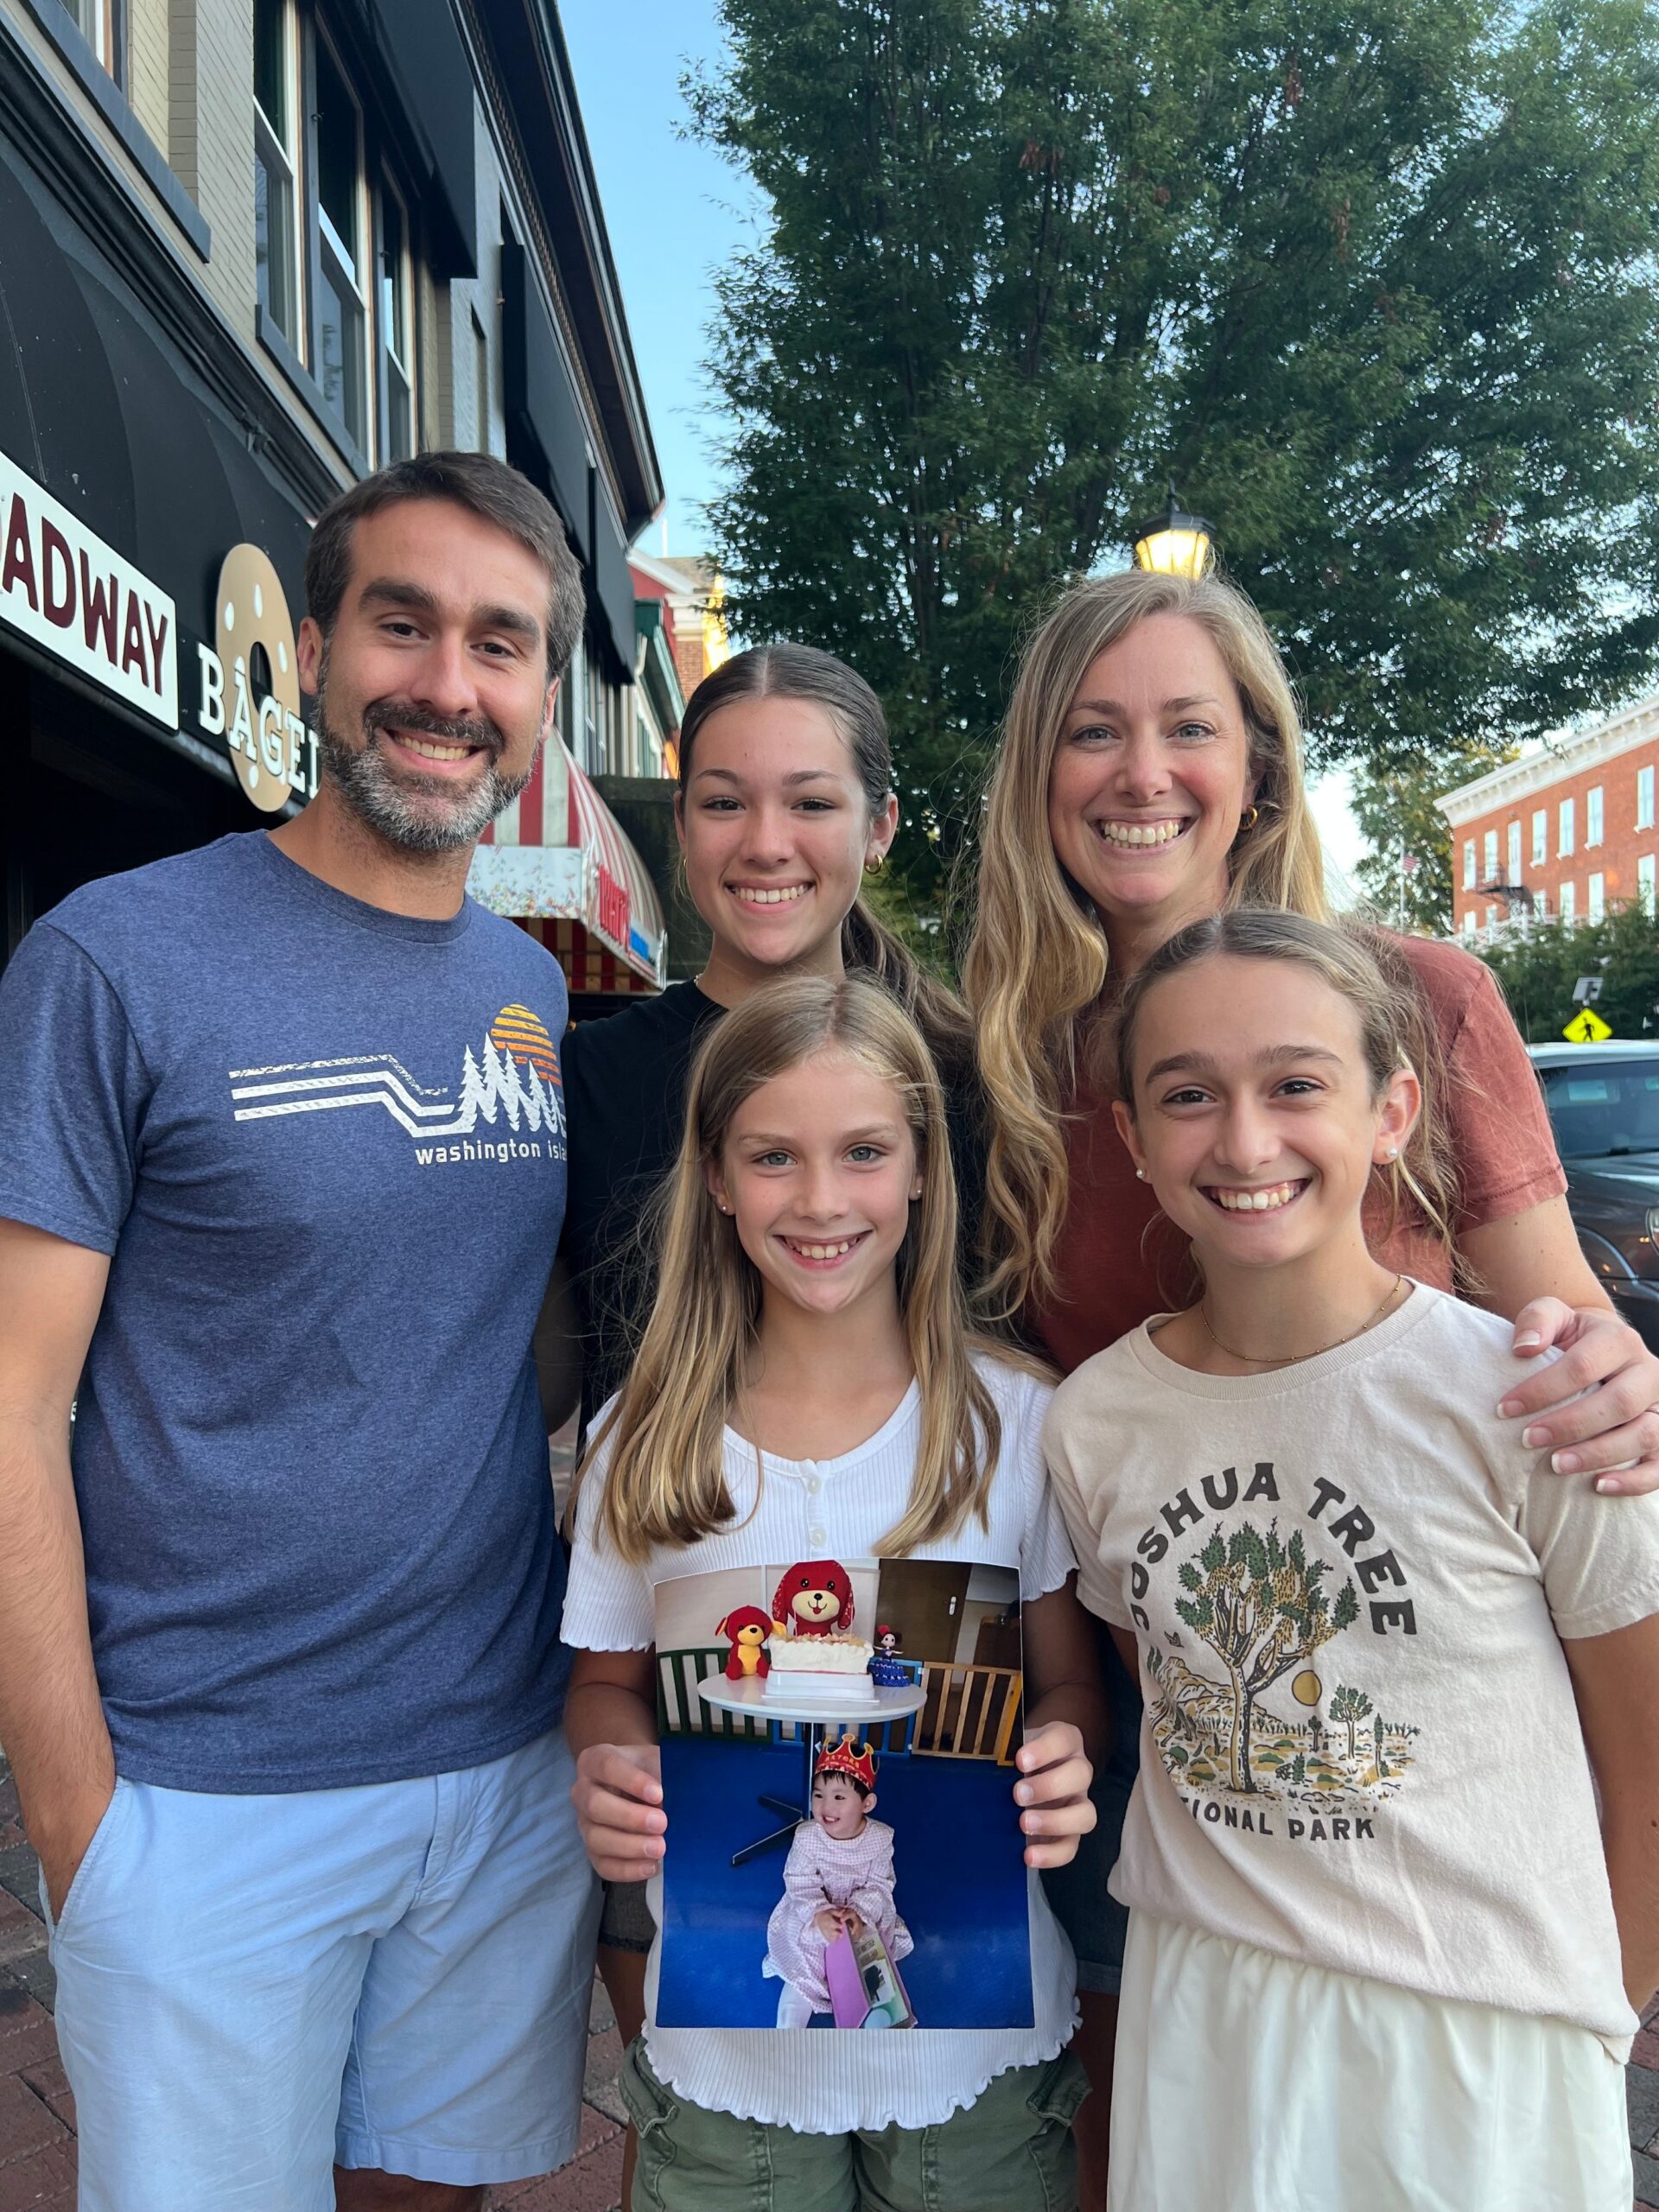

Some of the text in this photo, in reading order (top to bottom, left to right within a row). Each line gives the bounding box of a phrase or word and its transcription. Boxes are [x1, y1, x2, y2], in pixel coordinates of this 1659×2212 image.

[0, 492, 168, 696] ADWAY
[416, 1138, 541, 1165] washington
[1130, 1462, 1417, 1635] JOSHUA TREE
[1180, 1797, 1375, 1841] IONAL PARK
